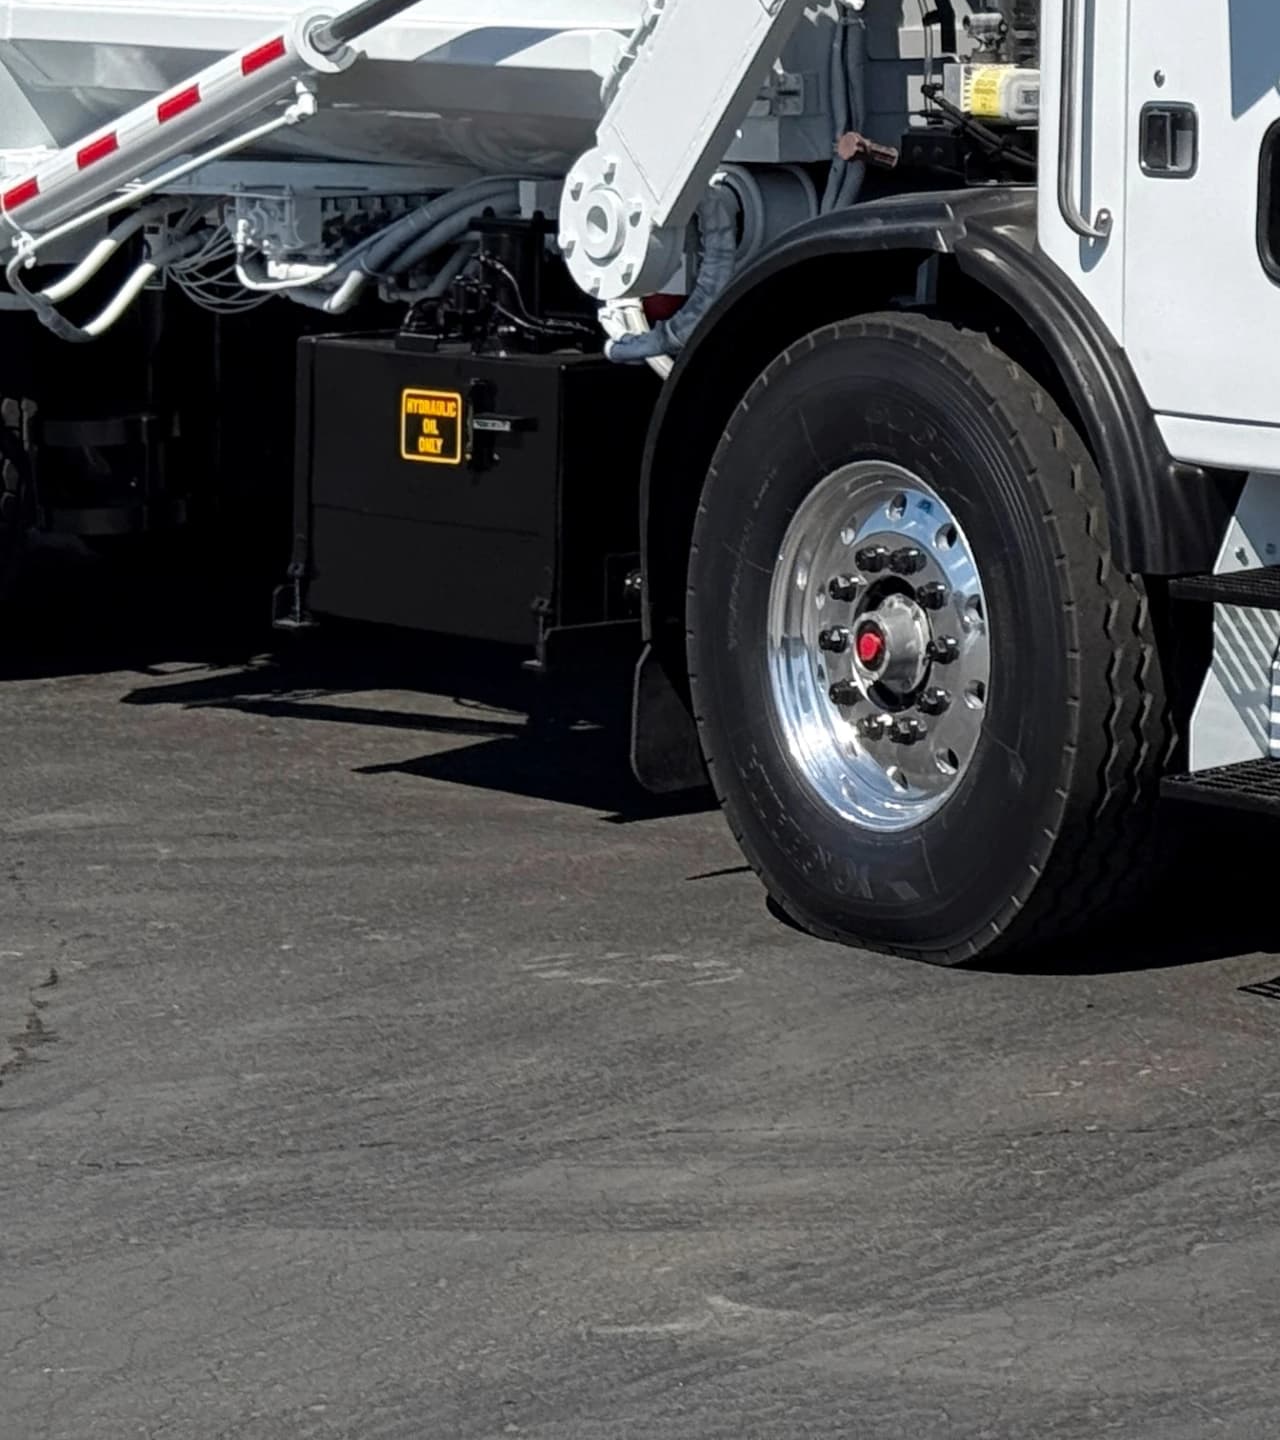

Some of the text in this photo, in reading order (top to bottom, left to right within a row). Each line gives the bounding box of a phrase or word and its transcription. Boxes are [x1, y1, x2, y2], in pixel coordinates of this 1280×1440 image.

[406, 398, 457, 418] HYDRAULIC
[422, 418, 439, 435] OIL
[418, 436, 443, 454] ONLY
